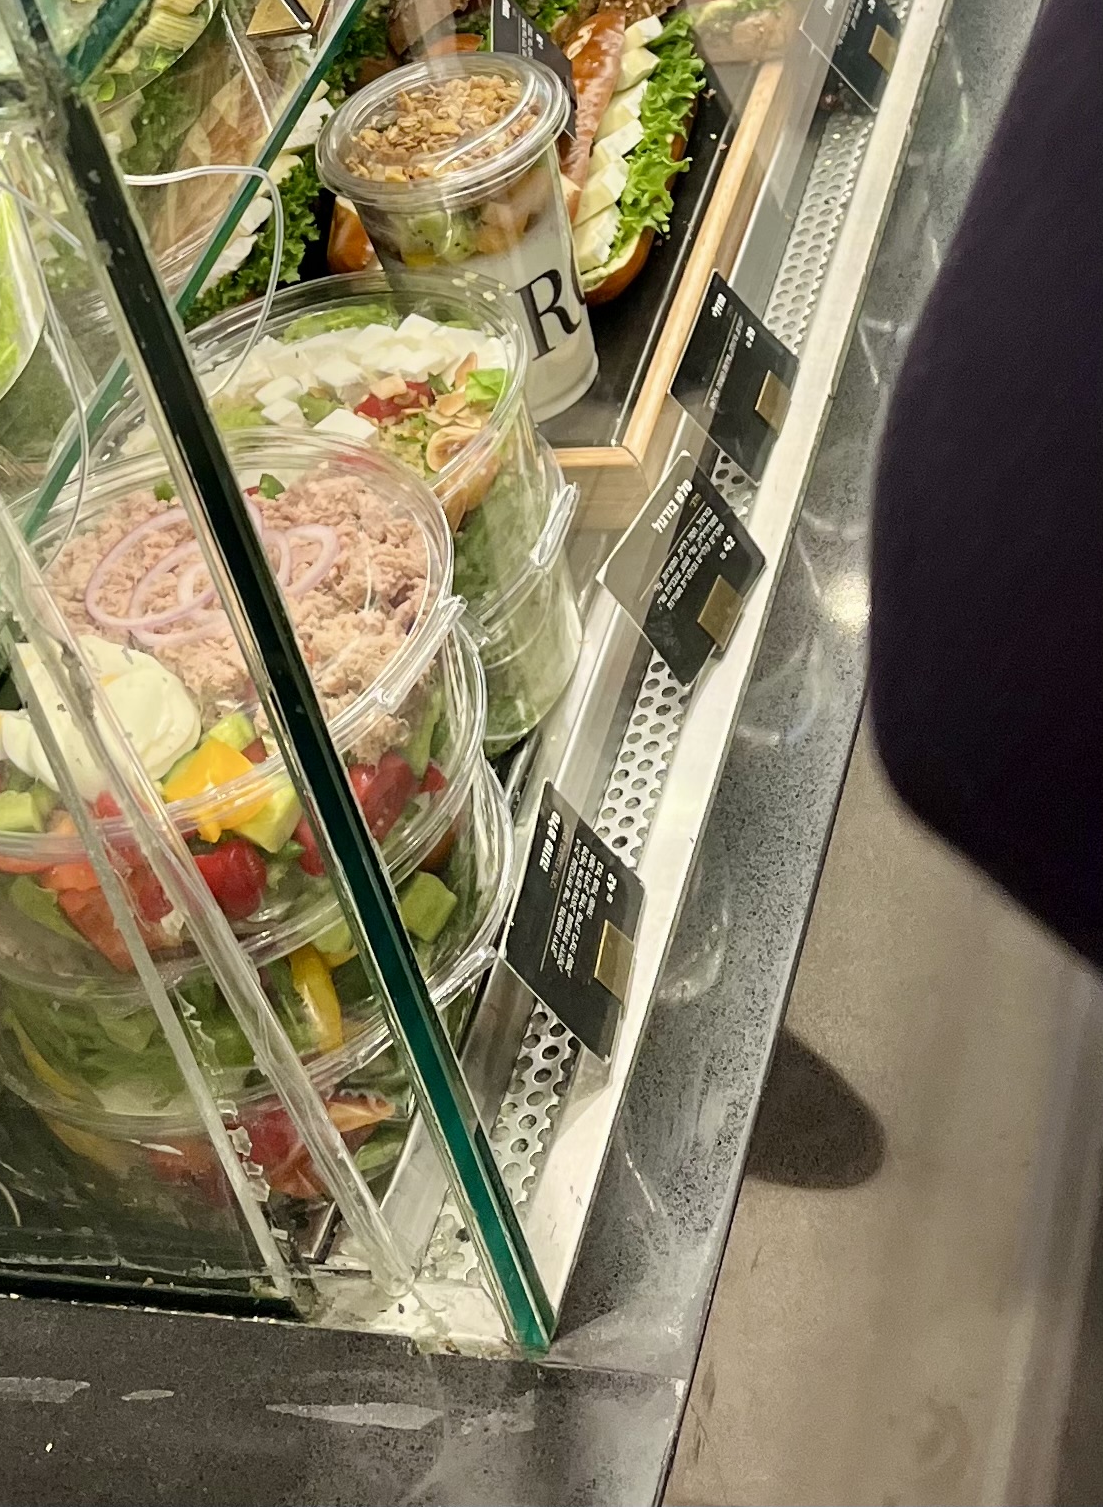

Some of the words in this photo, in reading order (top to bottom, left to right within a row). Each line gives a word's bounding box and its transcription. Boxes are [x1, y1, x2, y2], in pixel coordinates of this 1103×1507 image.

[711, 293, 727, 318] מוזלי
[674, 479, 693, 504] סלט
[651, 499, 679, 534] בורגול
[723, 535, 736, 552] 42
[547, 811, 561, 841] סלט
[539, 838, 554, 872] טונה
[594, 860, 604, 878] בצל
[606, 872, 617, 893] 42
